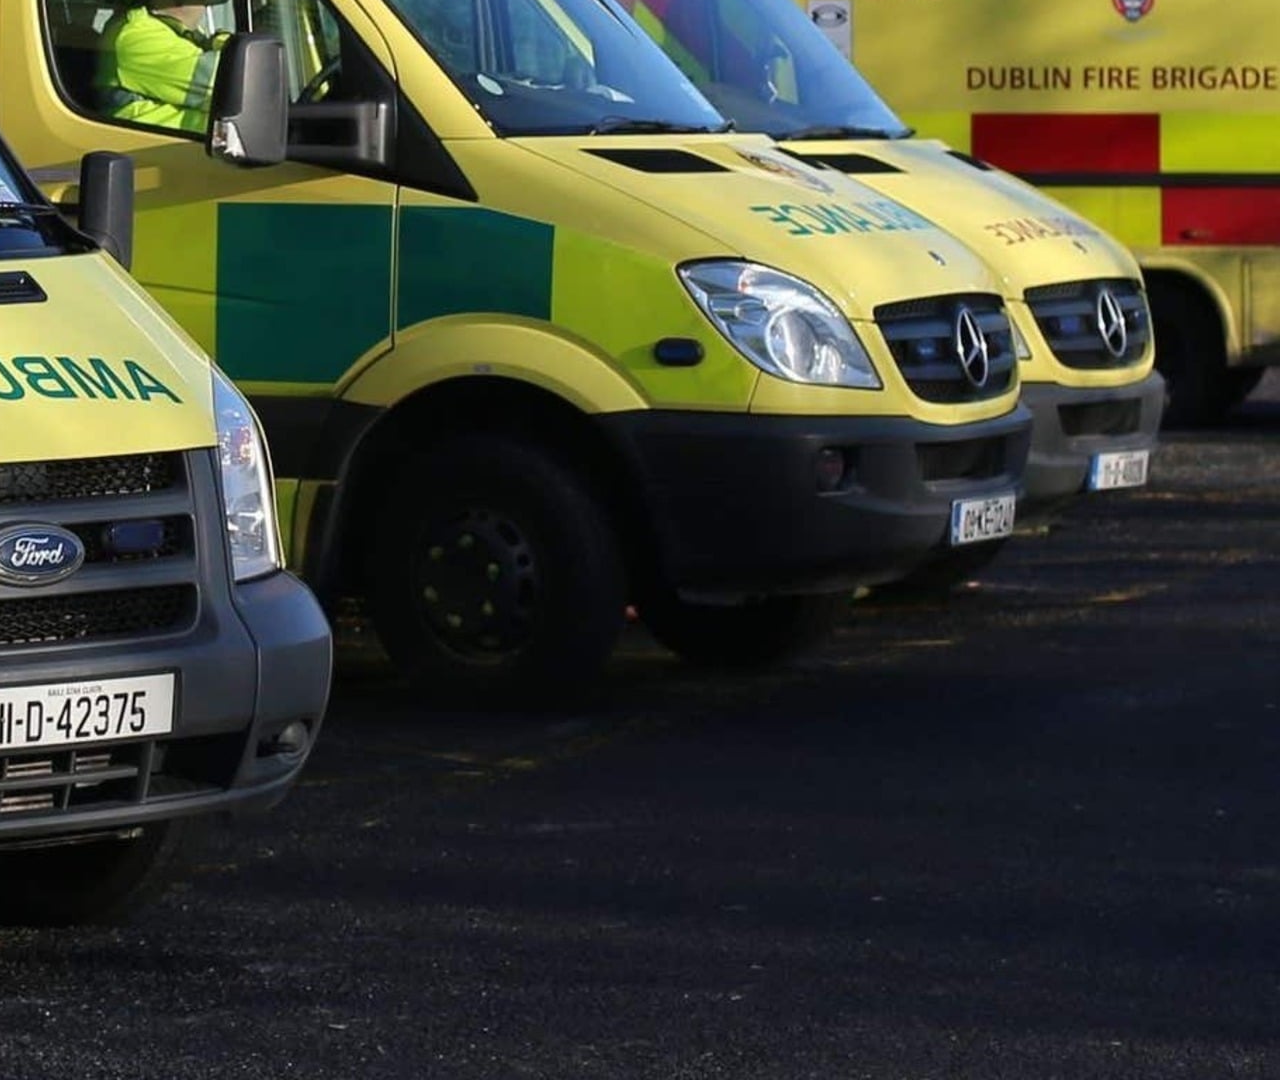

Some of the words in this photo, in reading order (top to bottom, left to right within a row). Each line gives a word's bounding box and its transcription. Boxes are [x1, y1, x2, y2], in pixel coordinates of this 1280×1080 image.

[967, 67, 1072, 91] DUBLIN
[1083, 67, 1140, 90] FIRE
[1152, 66, 1278, 90] BRIGADE
[11, 537, 64, 567] Ford
